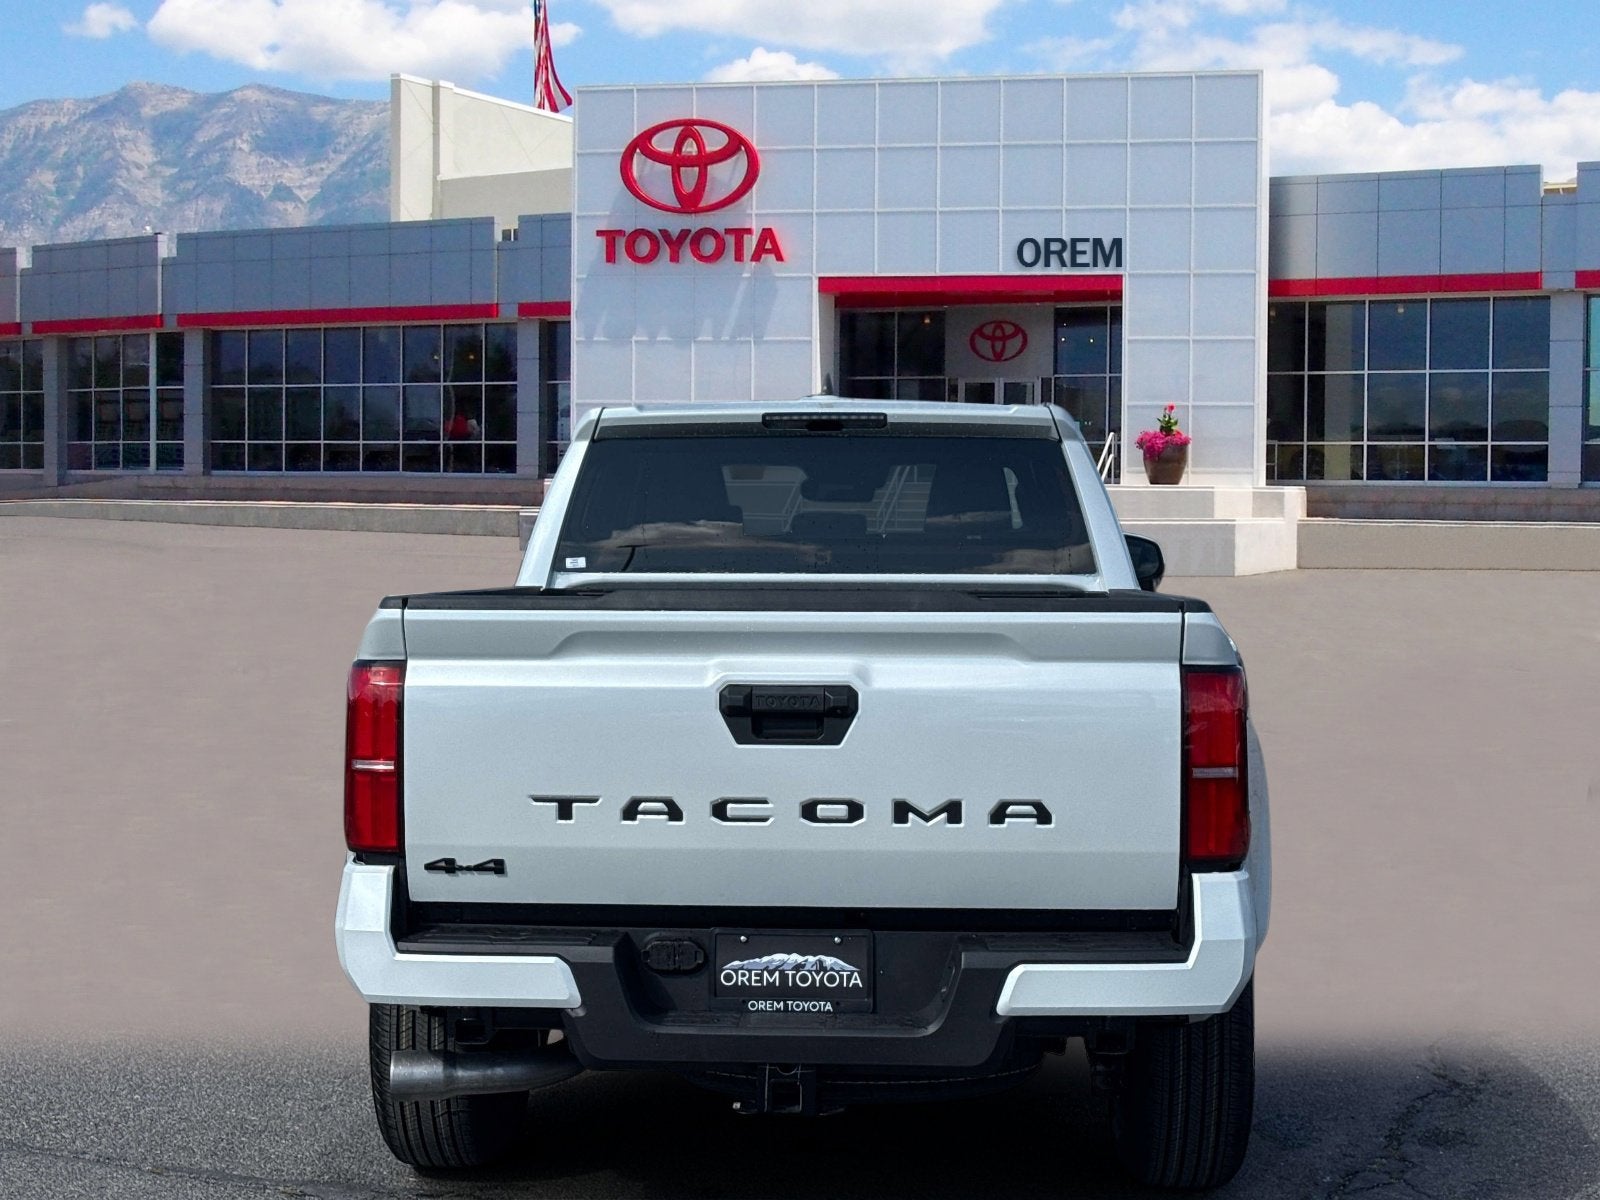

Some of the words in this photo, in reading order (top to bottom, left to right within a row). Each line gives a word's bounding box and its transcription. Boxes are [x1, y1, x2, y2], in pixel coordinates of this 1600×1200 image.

[596, 227, 785, 264] TOYOTA
[1016, 237, 1122, 267] OREM
[755, 694, 820, 708] TOYOTA
[530, 794, 1053, 827] TACOMA
[720, 969, 779, 987] OREM
[785, 970, 863, 988] TOYOTA
[748, 1000, 783, 1011] OREM
[787, 1001, 833, 1012] TOYOTA
